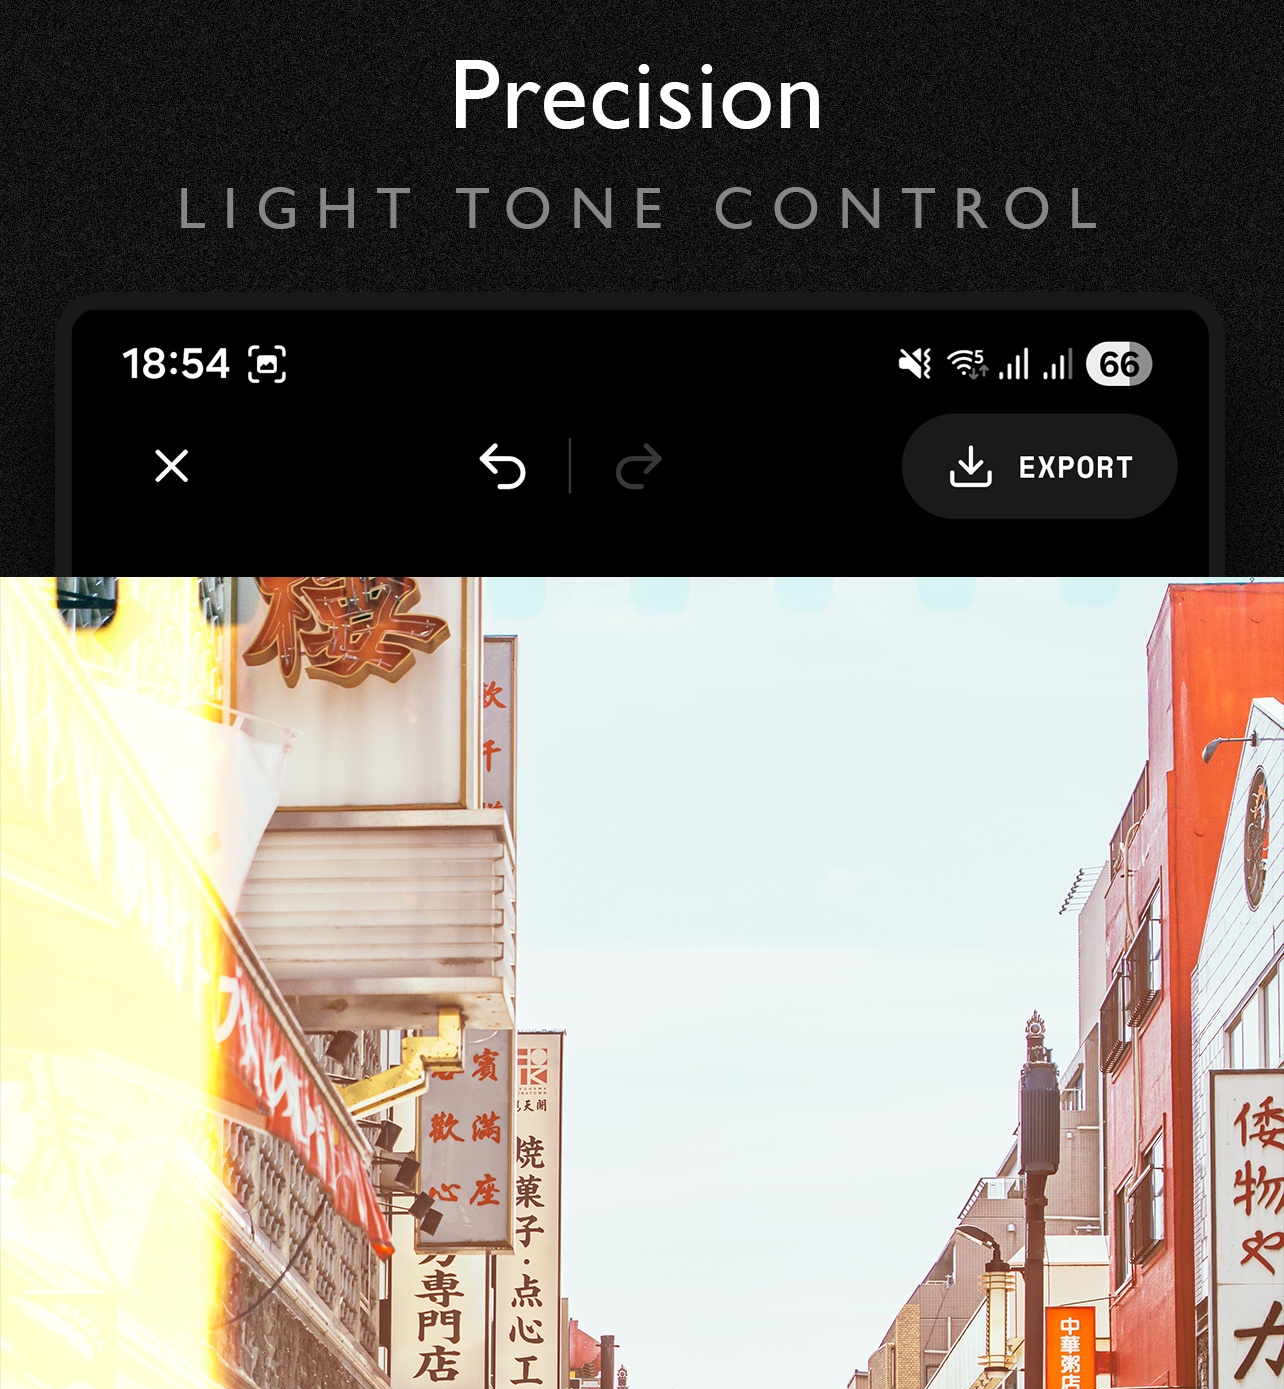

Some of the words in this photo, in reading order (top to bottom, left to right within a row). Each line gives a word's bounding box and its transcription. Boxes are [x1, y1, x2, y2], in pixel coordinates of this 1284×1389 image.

[122, 347, 230, 380] 18:54
[974, 349, 984, 364] 5
[1100, 351, 1140, 378] 66
[1019, 455, 1133, 479] EXPORT
[1233, 1095, 1284, 1276] 倭物や
